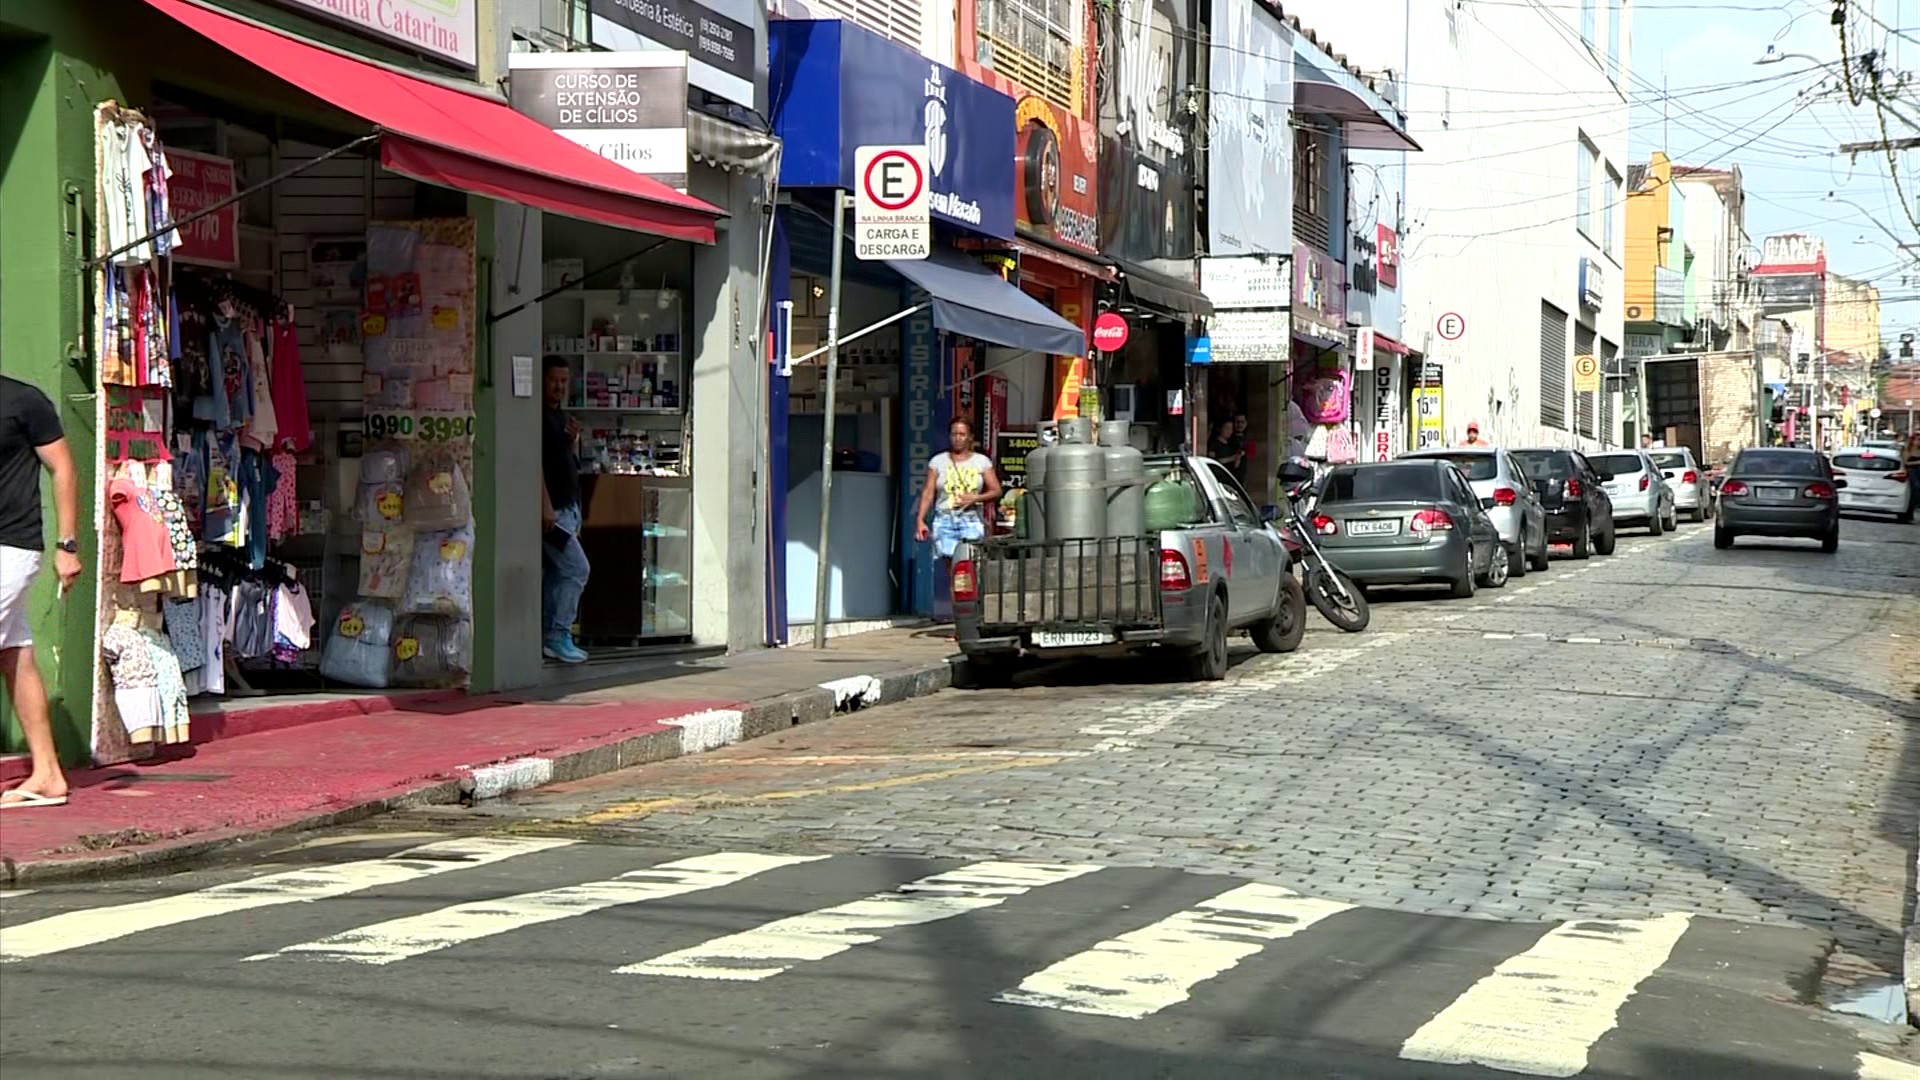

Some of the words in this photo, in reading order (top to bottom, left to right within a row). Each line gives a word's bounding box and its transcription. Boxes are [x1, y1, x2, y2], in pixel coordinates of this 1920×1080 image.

[310, 0, 371, 22] anta
[376, 0, 459, 53] Catarina
[662, 7, 694, 39] Estética
[555, 74, 612, 89] CURSO
[615, 74, 638, 89] DE
[557, 89, 641, 106] EXTENSÃO
[559, 109, 582, 124] DE
[586, 106, 638, 124] CÍLIOS
[882, 162, 905, 198] E
[895, 214, 925, 222] BRANCA
[866, 228, 909, 240] CARGA
[911, 228, 920, 240] E
[859, 243, 926, 256] DESCARGA
[1094, 326, 1124, 339] Coca-Cola
[1446, 319, 1456, 335] E
[1581, 361, 1590, 373] E
[1377, 366, 1391, 430] OUTLET
[1008, 438, 1040, 448] X-BACO
[1043, 632, 1066, 644] ERN
